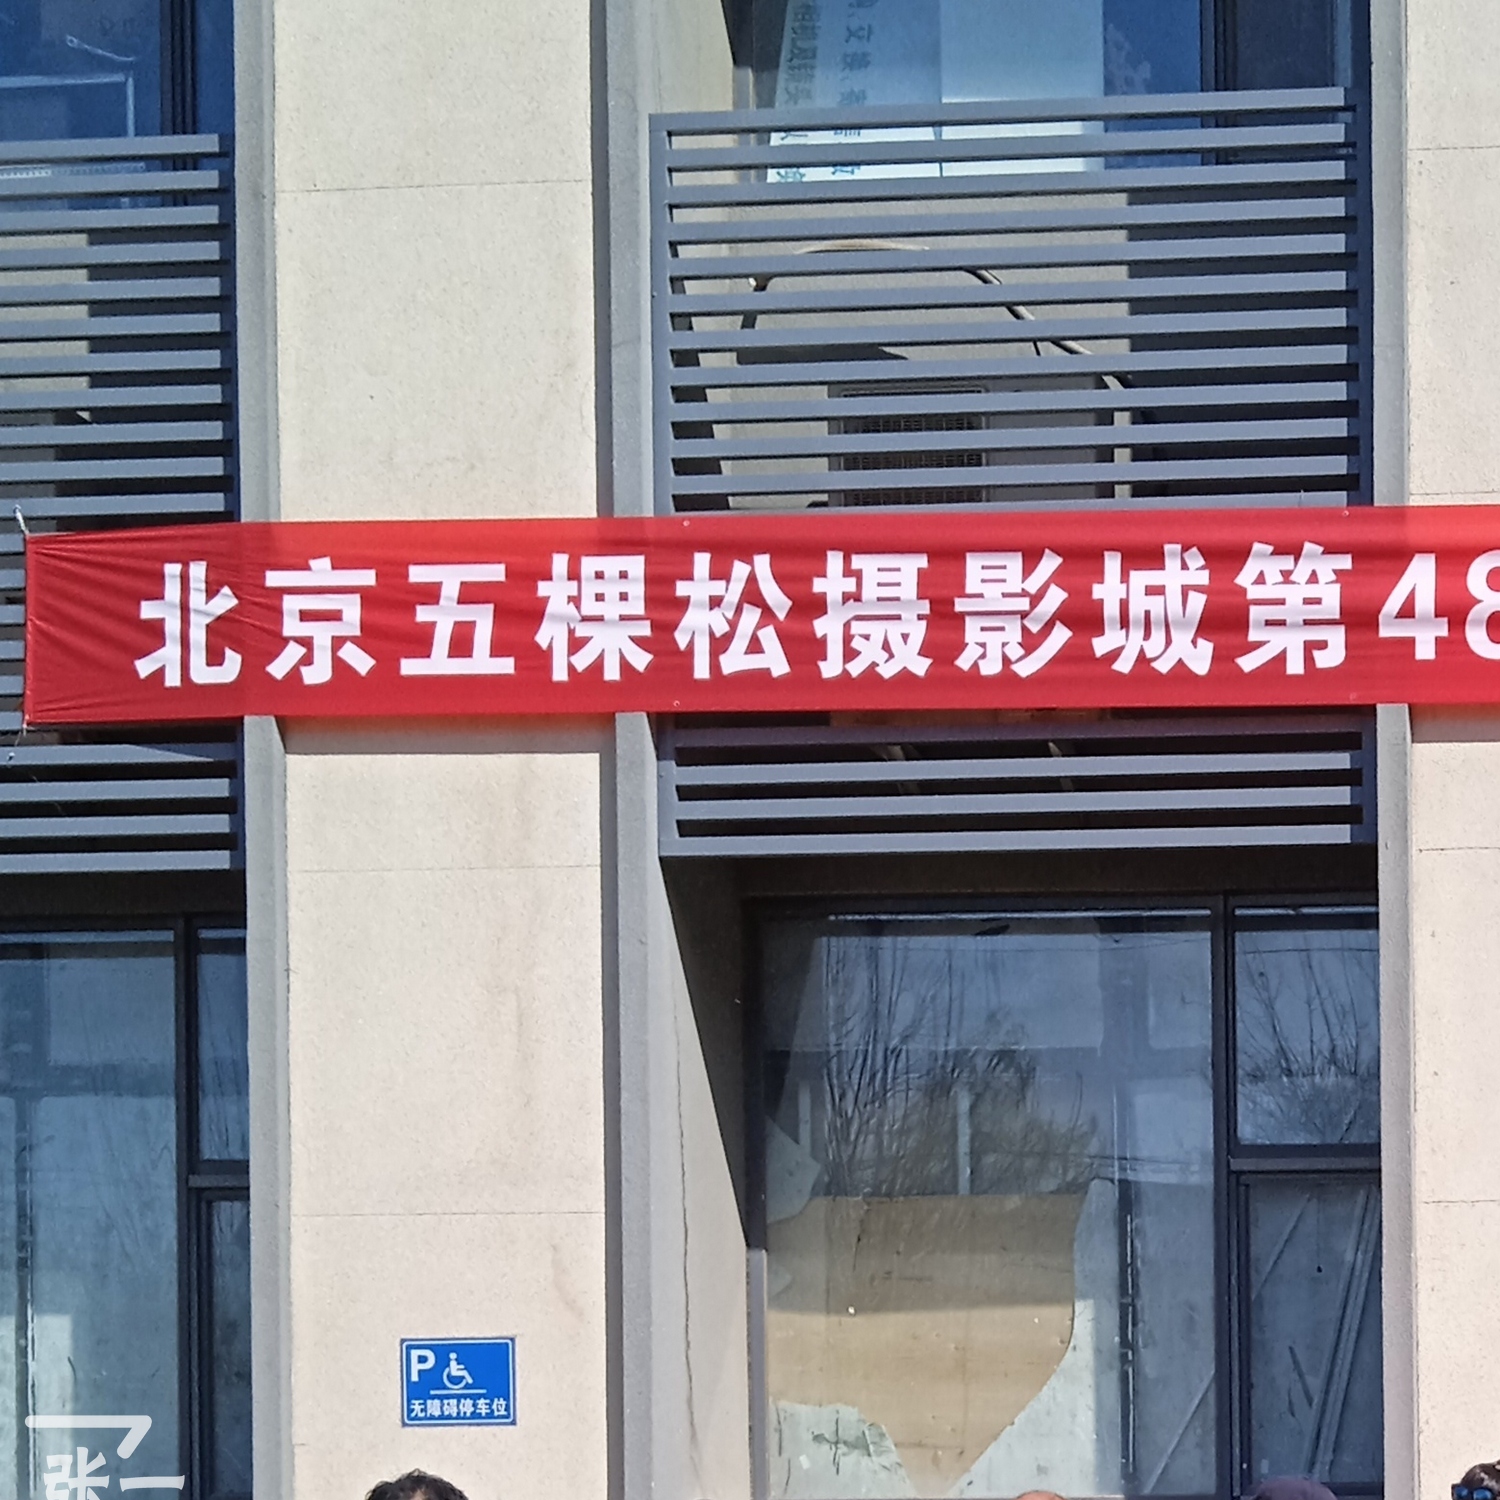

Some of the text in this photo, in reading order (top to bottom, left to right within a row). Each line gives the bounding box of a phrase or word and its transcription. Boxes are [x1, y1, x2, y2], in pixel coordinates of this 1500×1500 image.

[410, 1349, 436, 1382] P
[410, 1397, 508, 1418] 无障碍停车位
